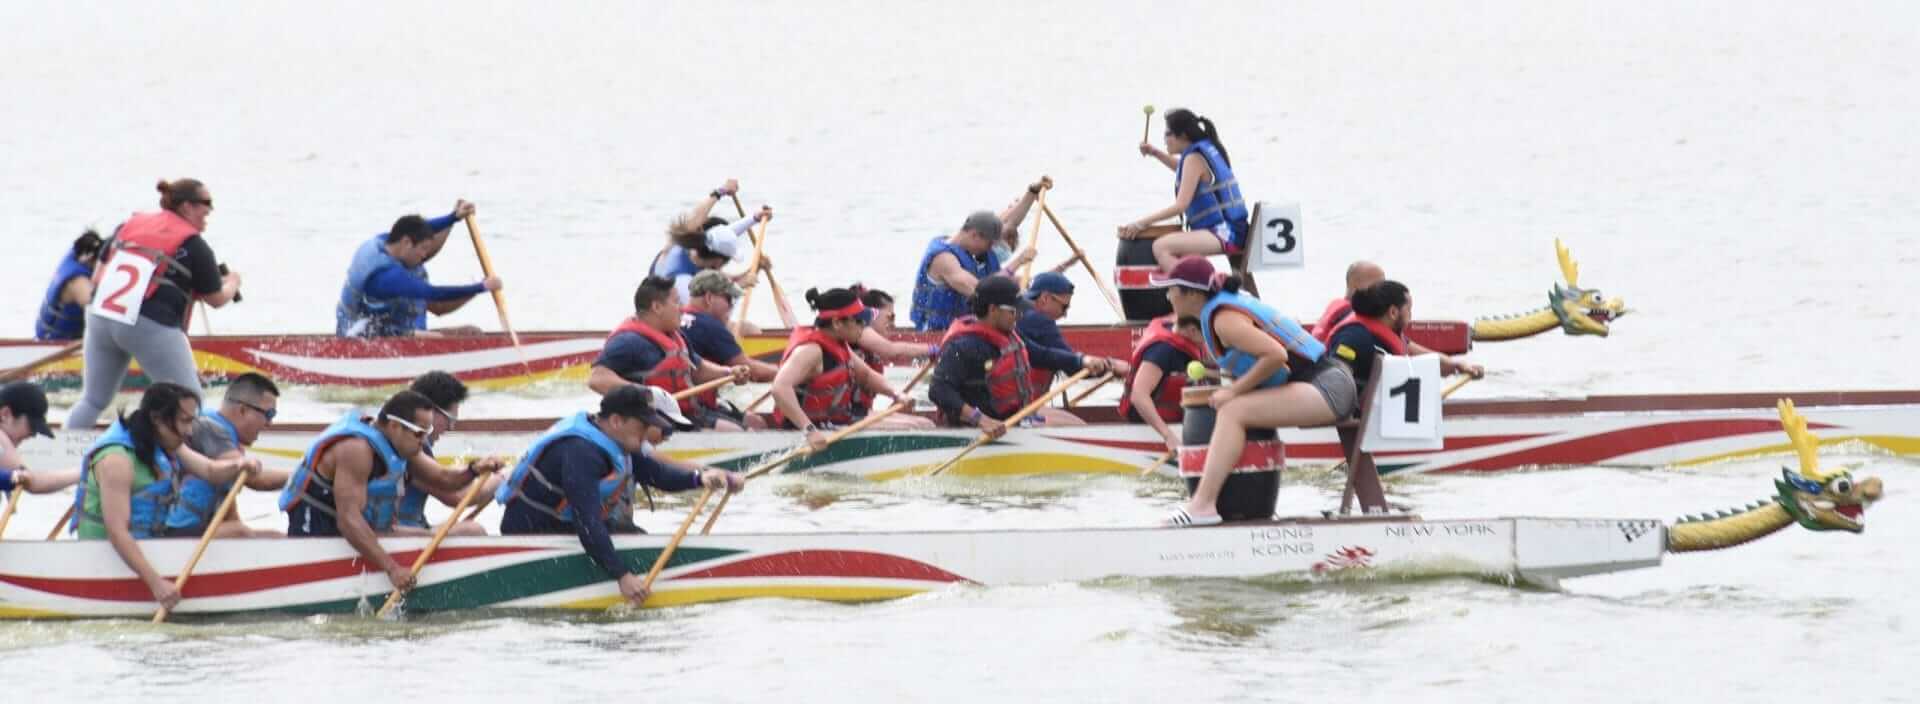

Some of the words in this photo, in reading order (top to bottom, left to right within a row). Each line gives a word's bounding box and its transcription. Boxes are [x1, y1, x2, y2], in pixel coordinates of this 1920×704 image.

[1266, 218, 1296, 253] 3
[101, 265, 140, 314] 2
[1389, 377, 1421, 424] 1
[1250, 527, 1314, 540] HONG
[1385, 526, 1434, 537] NEW
[1444, 525, 1496, 536] YORK
[1250, 543, 1314, 556] KONG
